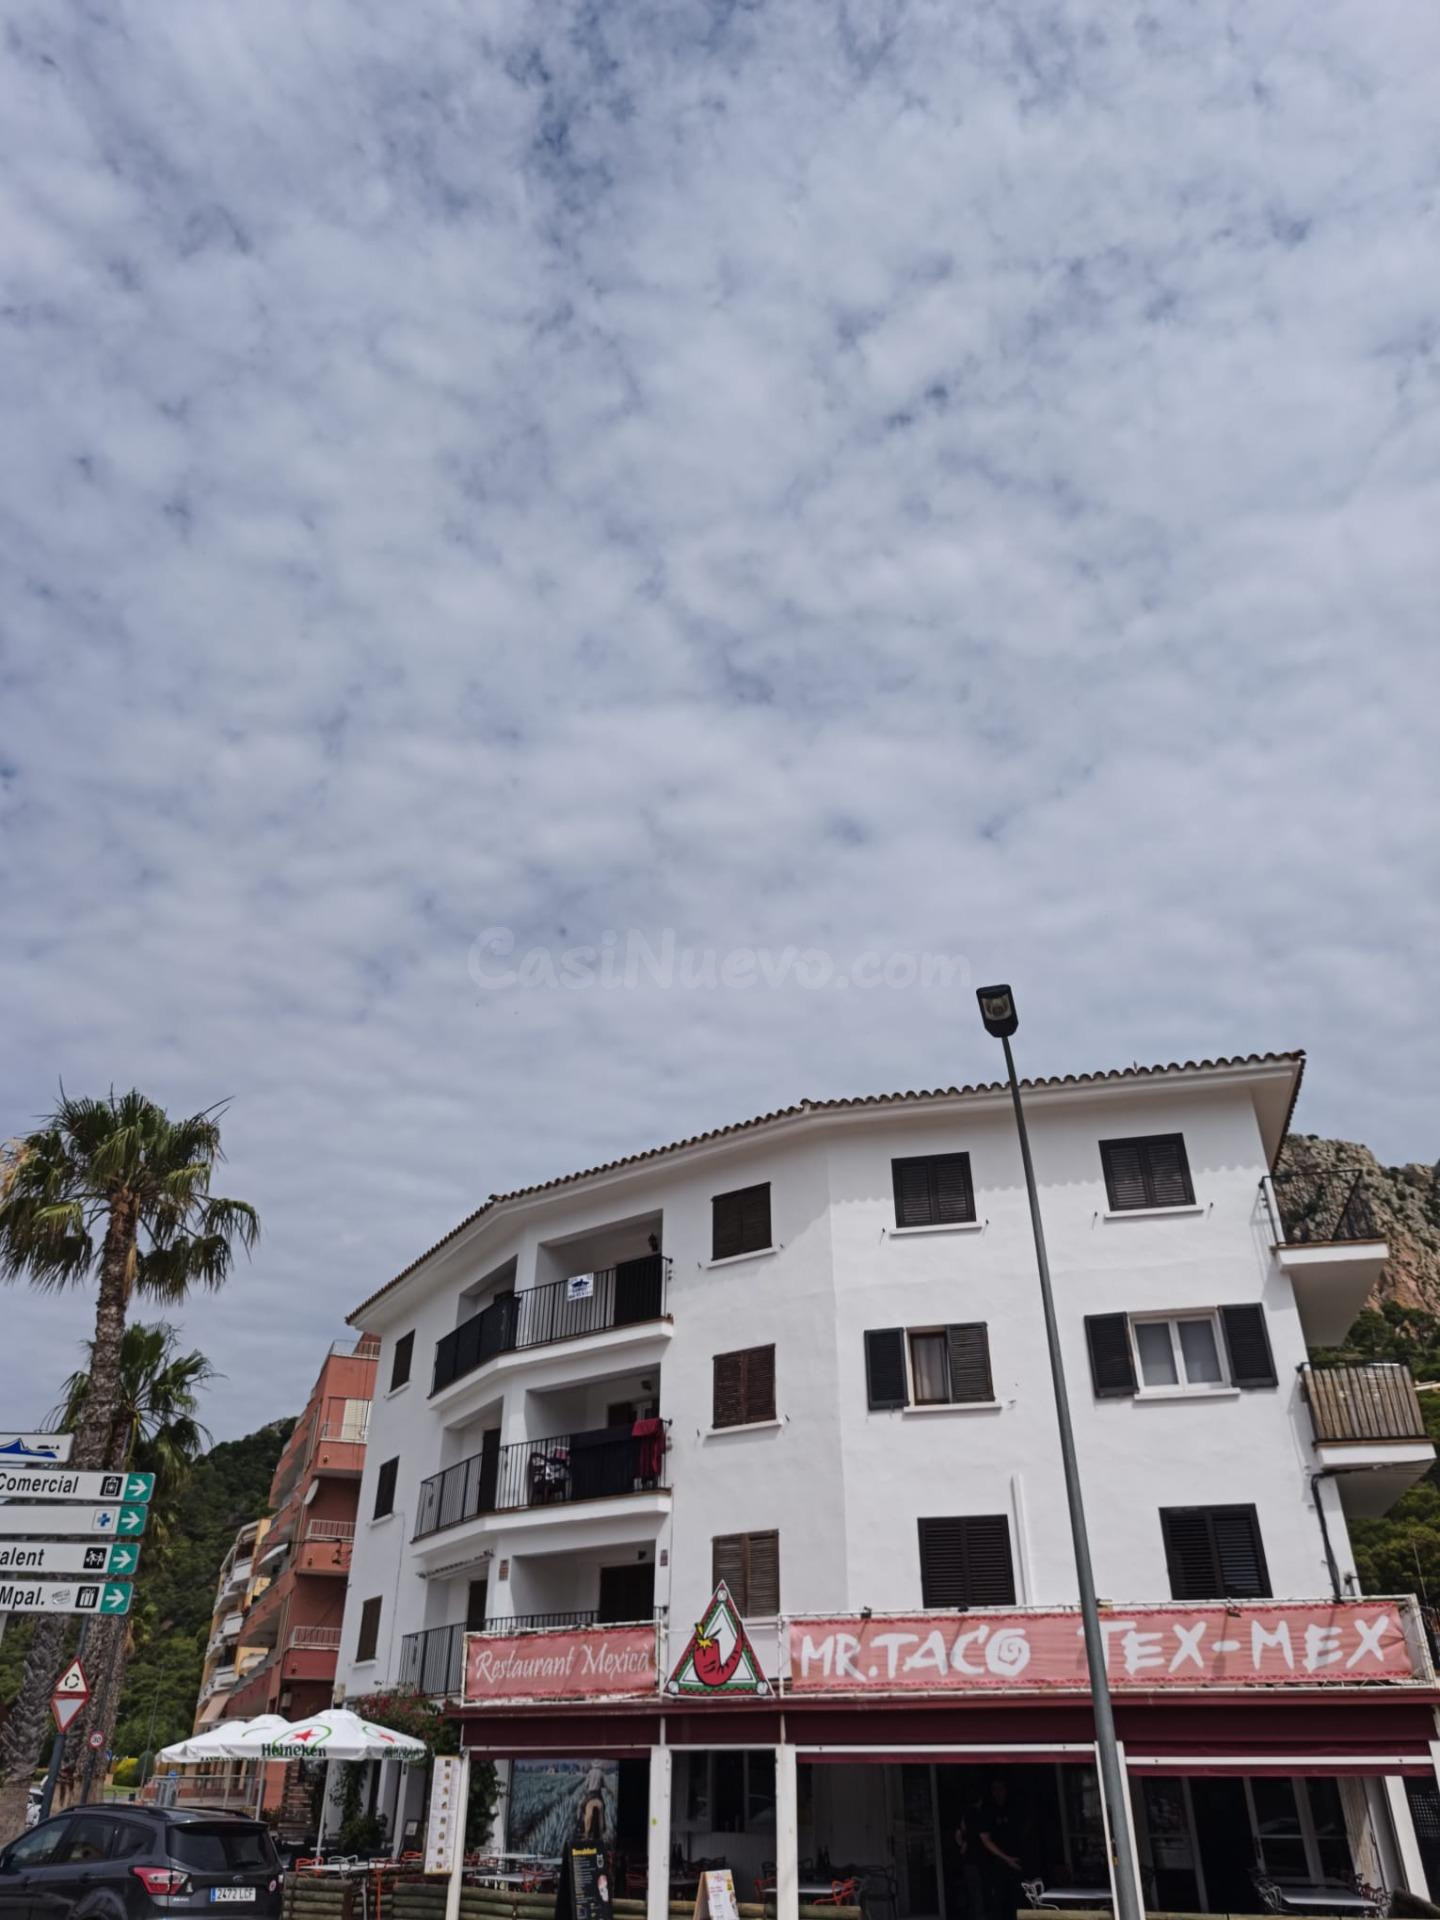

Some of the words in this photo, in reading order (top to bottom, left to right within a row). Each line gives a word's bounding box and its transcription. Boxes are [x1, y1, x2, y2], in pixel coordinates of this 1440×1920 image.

[0, 1472, 79, 1494] Comercial
[0, 1586, 45, 1610] Mpal.
[1077, 1615, 1389, 1675] TEX-MEX
[475, 1645, 575, 1684] Restaurant
[581, 1643, 650, 1680] Mexicà
[261, 1743, 327, 1758] Heineken
